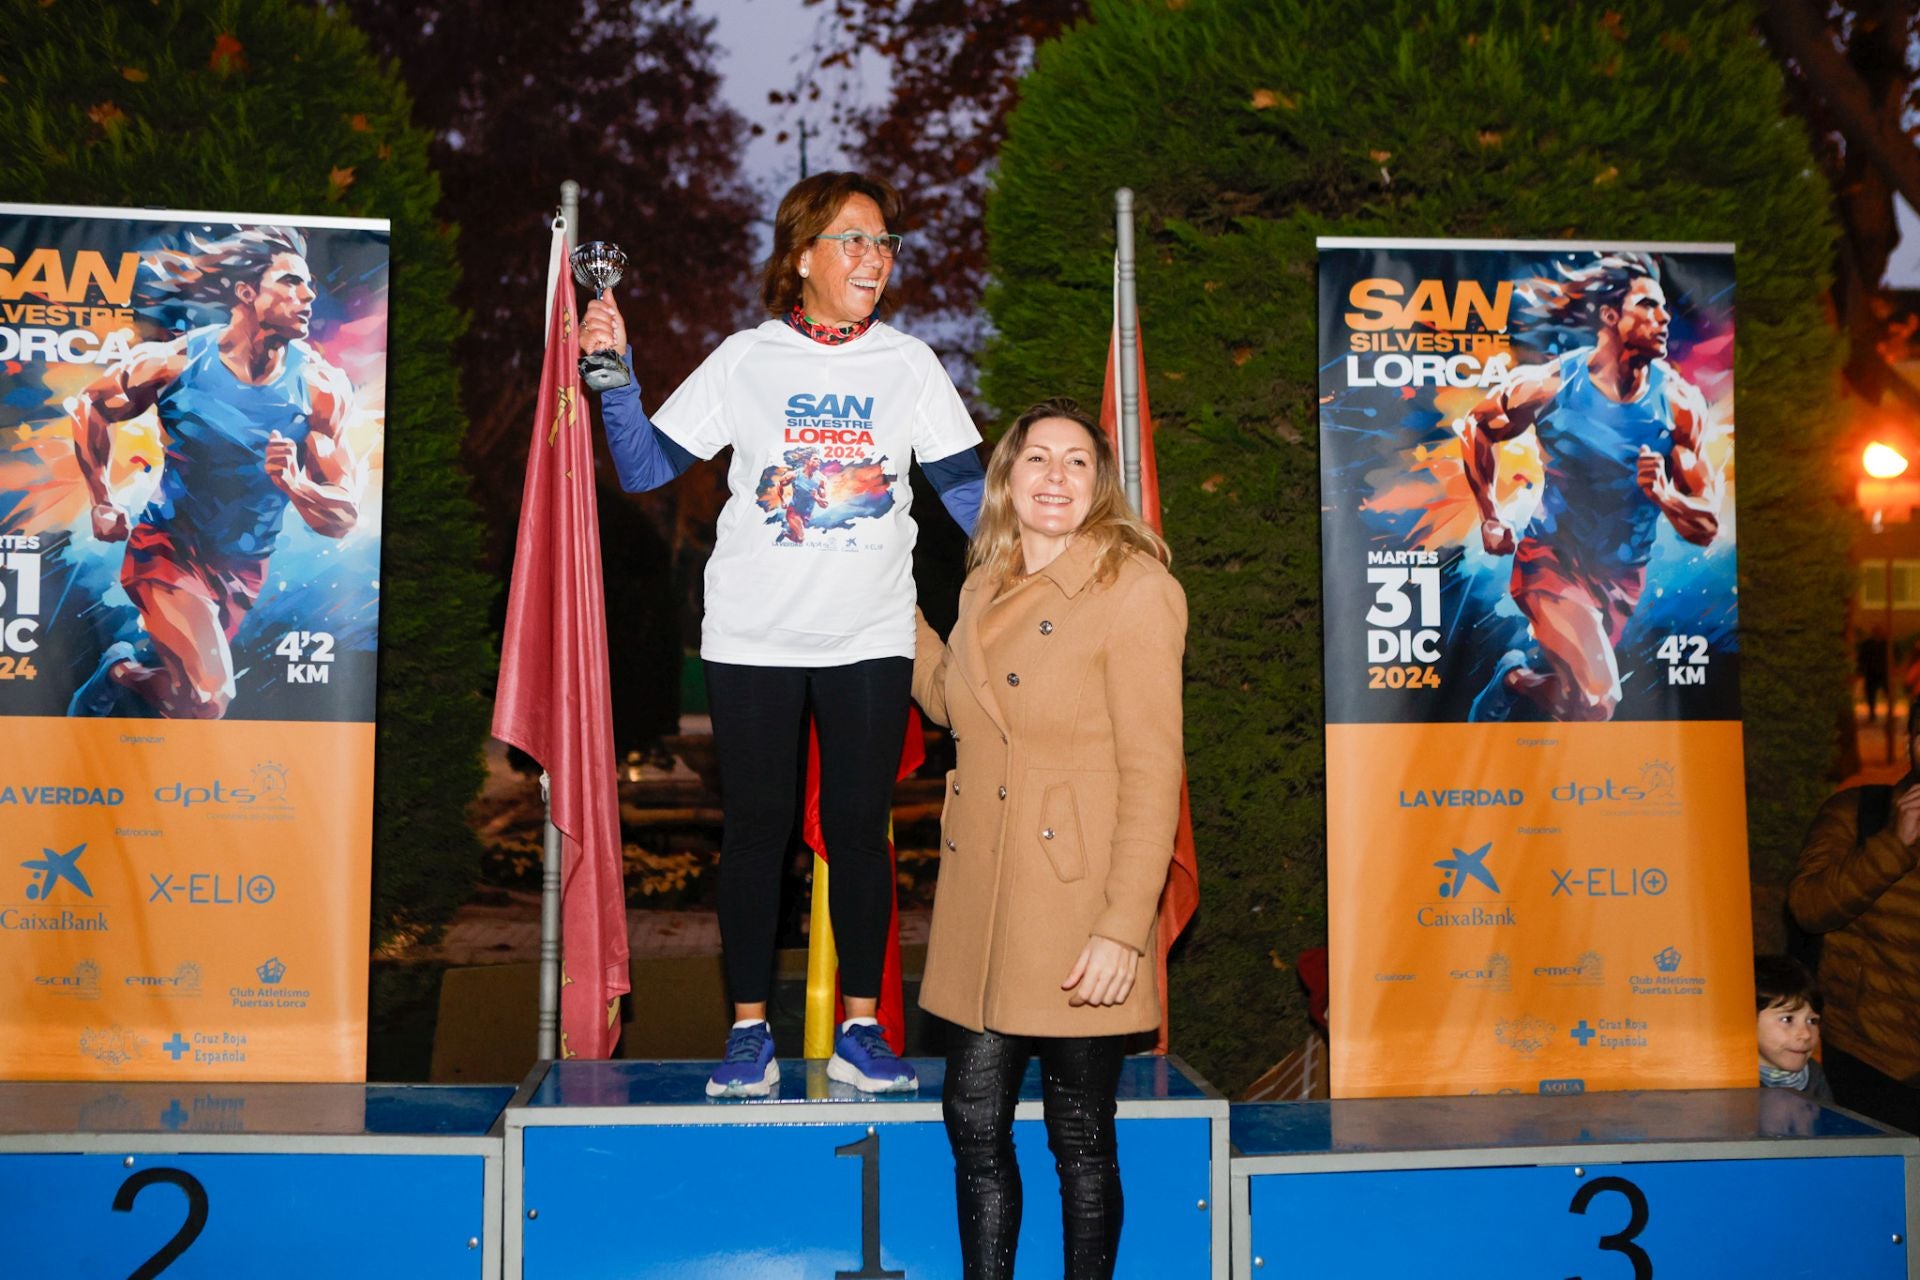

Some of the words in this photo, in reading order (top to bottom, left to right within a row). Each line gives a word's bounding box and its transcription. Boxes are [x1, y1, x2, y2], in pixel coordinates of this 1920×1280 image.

[0, 246, 141, 304] AN
[1344, 278, 1514, 331] SAN
[0, 304, 134, 327] VESTRE
[1350, 333, 1511, 352] SILVESTRE
[1346, 354, 1510, 387] LORCA
[784, 393, 875, 419] SAN
[787, 419, 873, 429] SILVESTRE
[784, 428, 875, 446] LORCA
[824, 446, 865, 459] 2024
[0, 535, 40, 549] TES
[1367, 551, 1439, 565] MARTES
[0, 552, 41, 615] 1
[1365, 567, 1441, 627] 31
[275, 631, 335, 662] 4'2
[1367, 629, 1441, 663] DIC
[1656, 634, 1709, 664] 4'2
[287, 663, 329, 684] KM
[1367, 666, 1441, 689] 2024
[1668, 666, 1706, 685] KM
[21, 786, 125, 806] VERDAD
[154, 780, 257, 808] dpts
[1399, 790, 1430, 807] LA
[1431, 788, 1525, 807] VERDAD
[1551, 778, 1646, 806] dpts
[149, 873, 276, 904] X-ELIO
[1551, 868, 1668, 896] X-ELIO
[0, 908, 109, 931] CaixaBank
[1417, 906, 1517, 927] CaixaBank
[1629, 976, 1653, 985] Club
[1655, 976, 1706, 985] Atletismo
[1632, 986, 1671, 995] Puertas
[1674, 986, 1703, 995] Lorca
[229, 987, 255, 998] Club
[257, 987, 310, 998] Atletismo
[232, 998, 274, 1008] Puertas
[276, 999, 306, 1008] Lorca
[1598, 1018, 1622, 1030] Cruz
[1625, 1018, 1648, 1032] Roja
[194, 1032, 219, 1044] Cruz
[223, 1032, 247, 1047] Roja
[1600, 1034, 1648, 1050] Española
[194, 1049, 246, 1065] Española
[1543, 1082, 1582, 1093] AQUA
[835, 1133, 905, 1280] 1
[112, 1167, 209, 1280] 2
[1564, 1176, 1653, 1280] 3
